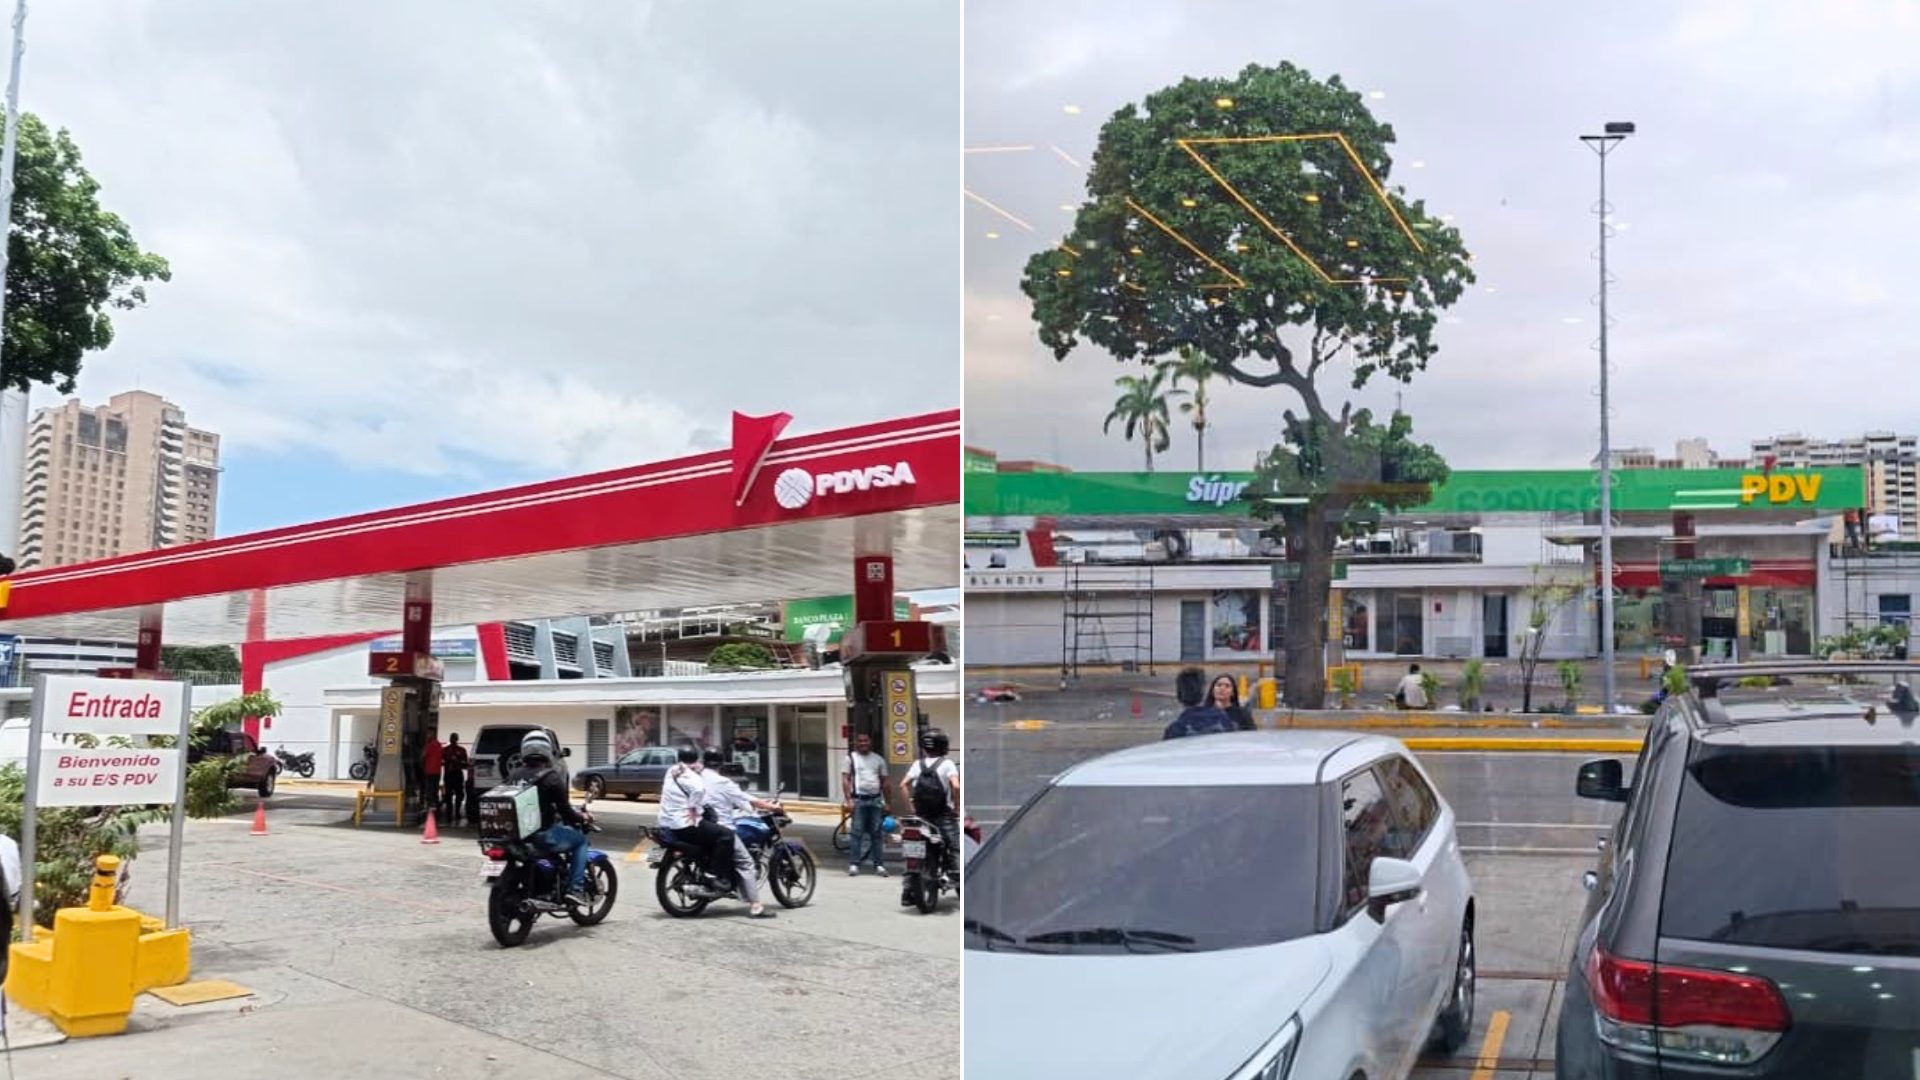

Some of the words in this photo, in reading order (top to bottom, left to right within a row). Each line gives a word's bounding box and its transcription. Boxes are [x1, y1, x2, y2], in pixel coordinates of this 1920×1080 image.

[816, 461, 916, 496] PDVSA
[1741, 474, 1822, 502] PDV
[890, 629, 902, 648] 1
[386, 657, 399, 672] 2
[68, 691, 161, 718] Entrada
[58, 754, 160, 769] Bienvenido
[54, 777, 63, 787] a
[68, 777, 88, 787] su
[92, 773, 119, 786] E/S
[123, 773, 158, 786] PDV
